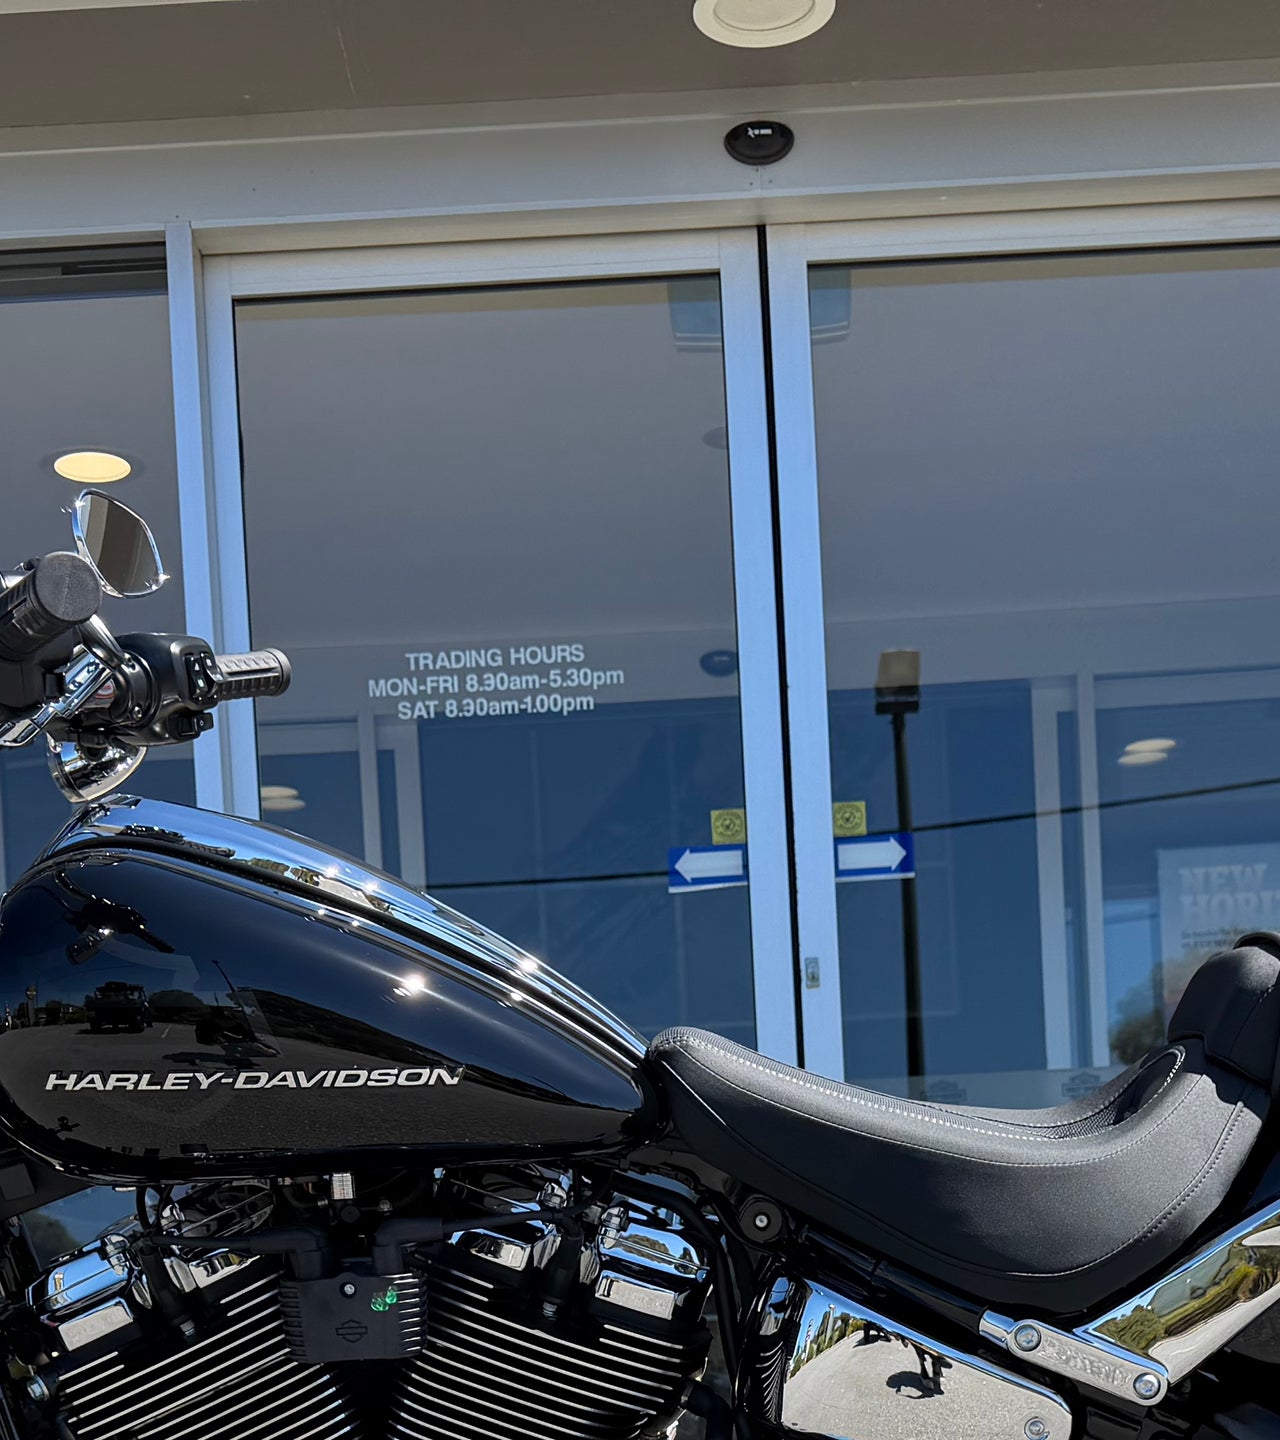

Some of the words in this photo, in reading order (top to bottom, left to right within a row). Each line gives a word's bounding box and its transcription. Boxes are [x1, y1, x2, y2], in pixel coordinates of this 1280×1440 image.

[405, 648, 503, 671] TRADING
[509, 643, 586, 666] HOURS
[368, 675, 459, 698] MON-FRI
[397, 701, 439, 720] SAT
[44, 1064, 467, 1092] HARLEY-DAVIDSON
